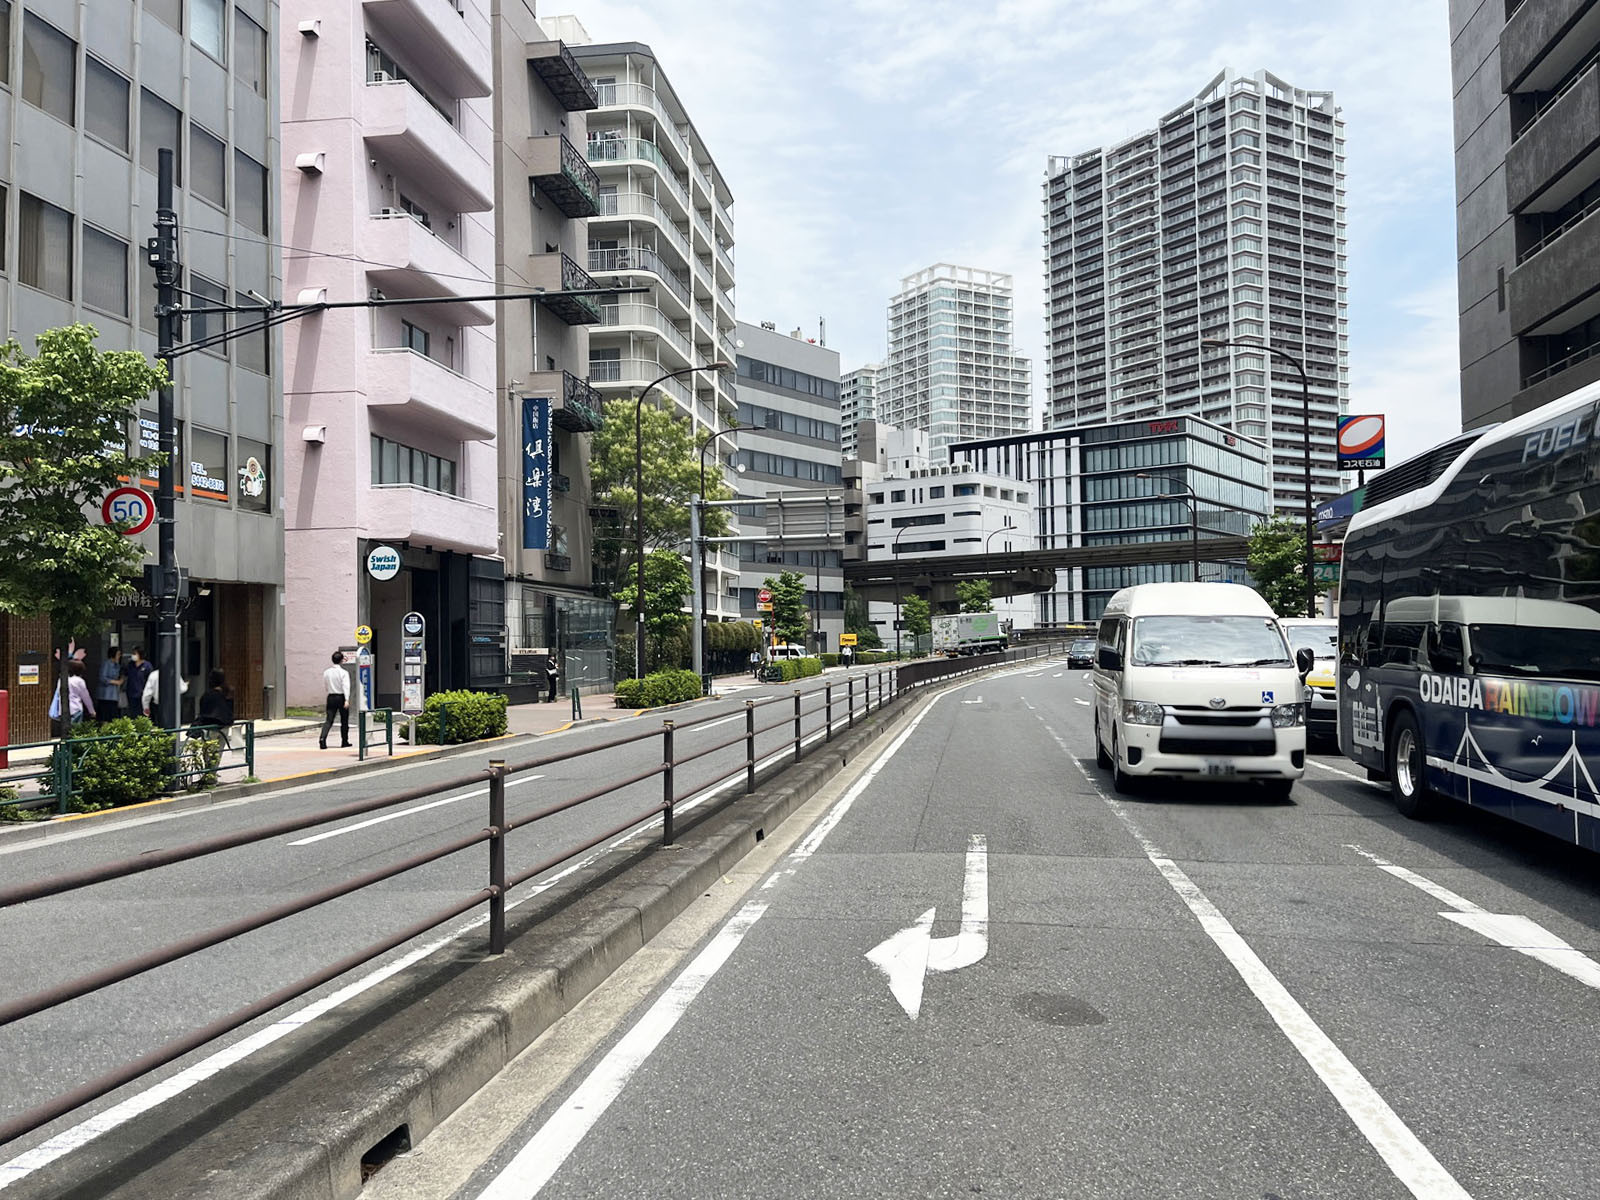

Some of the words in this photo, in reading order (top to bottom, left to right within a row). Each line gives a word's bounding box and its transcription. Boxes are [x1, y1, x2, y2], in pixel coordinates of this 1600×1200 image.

[1521, 416, 1587, 465] FUEL
[1343, 459, 1381, 469] コスモ石油
[113, 501, 142, 522] 50
[370, 555, 396, 564] Swish
[370, 563, 396, 572] Japan
[1419, 673, 1484, 710] ODAIBA
[1485, 680, 1598, 728] RAINBOW
